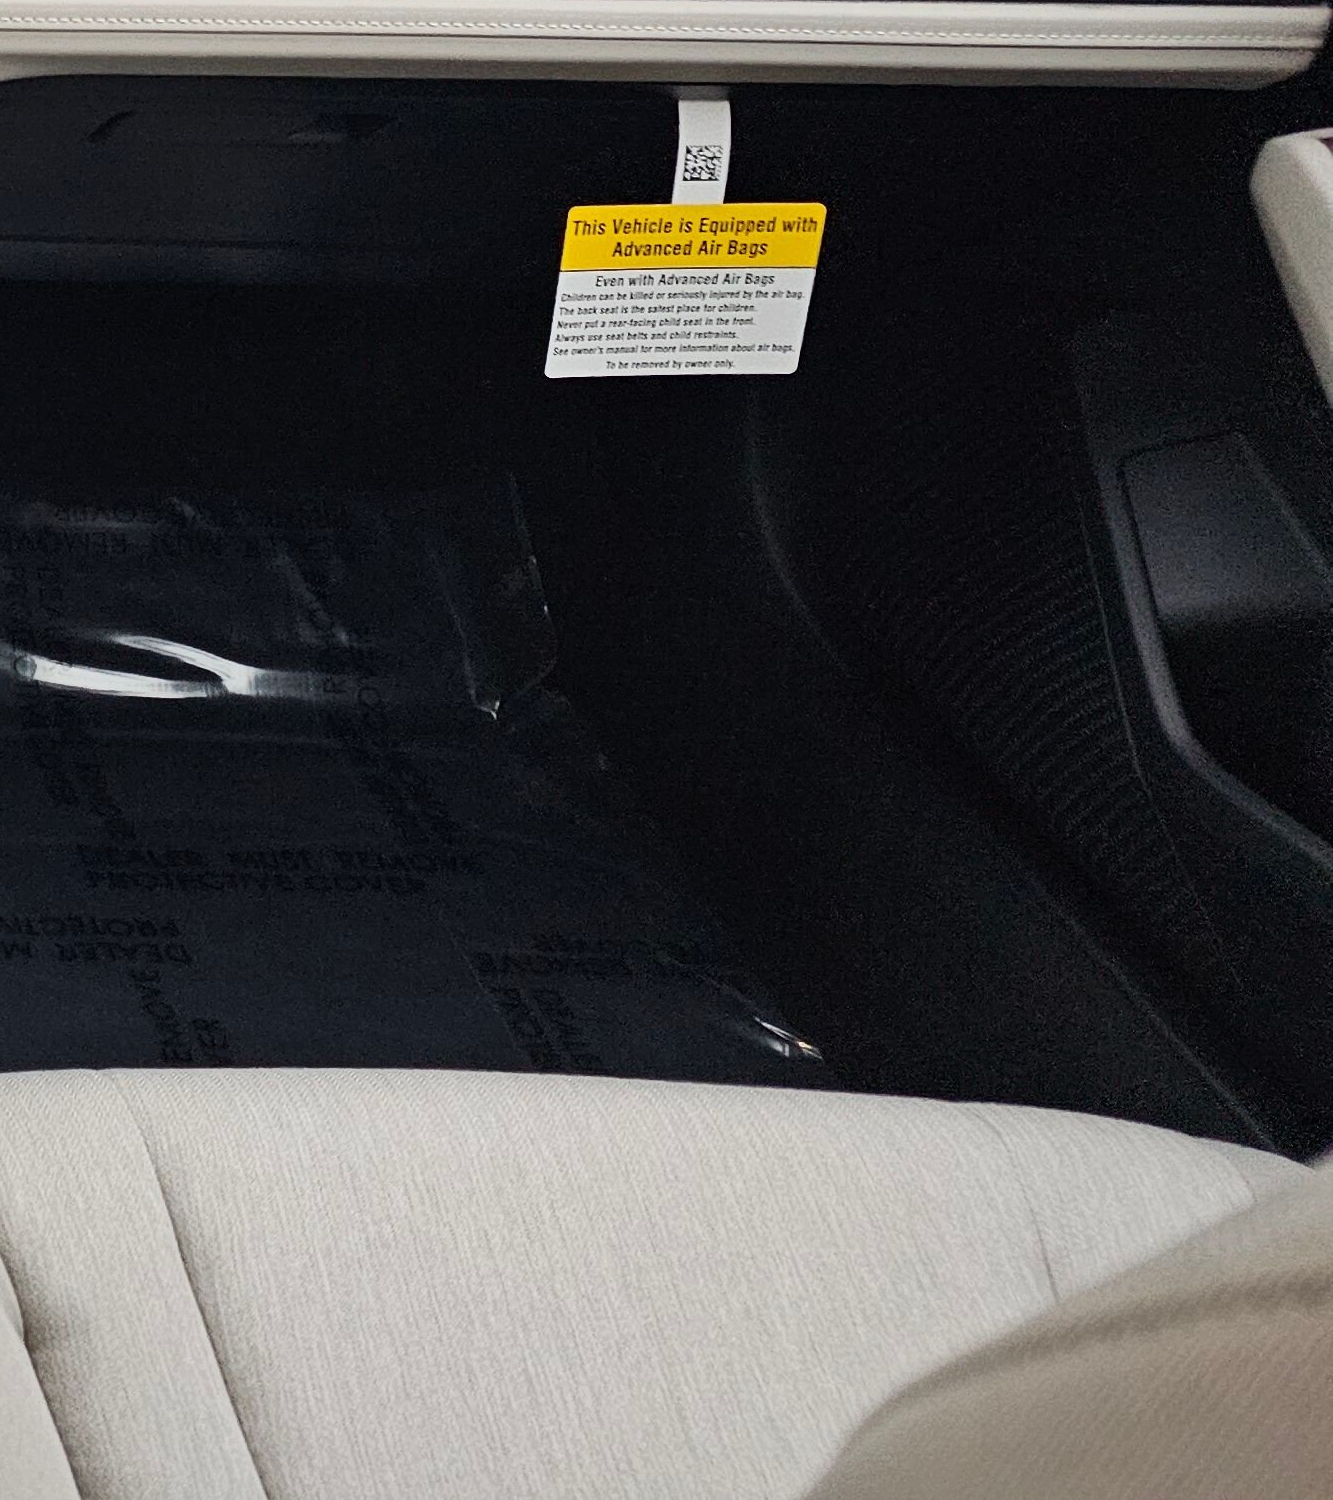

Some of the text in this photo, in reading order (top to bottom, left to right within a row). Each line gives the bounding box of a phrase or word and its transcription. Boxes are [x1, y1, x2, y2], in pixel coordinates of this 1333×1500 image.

[573, 217, 818, 236] This Vehicle is Equipped with
[612, 240, 769, 258] Advanced Air Bags
[595, 273, 776, 288] Even with Advanced Air Bags
